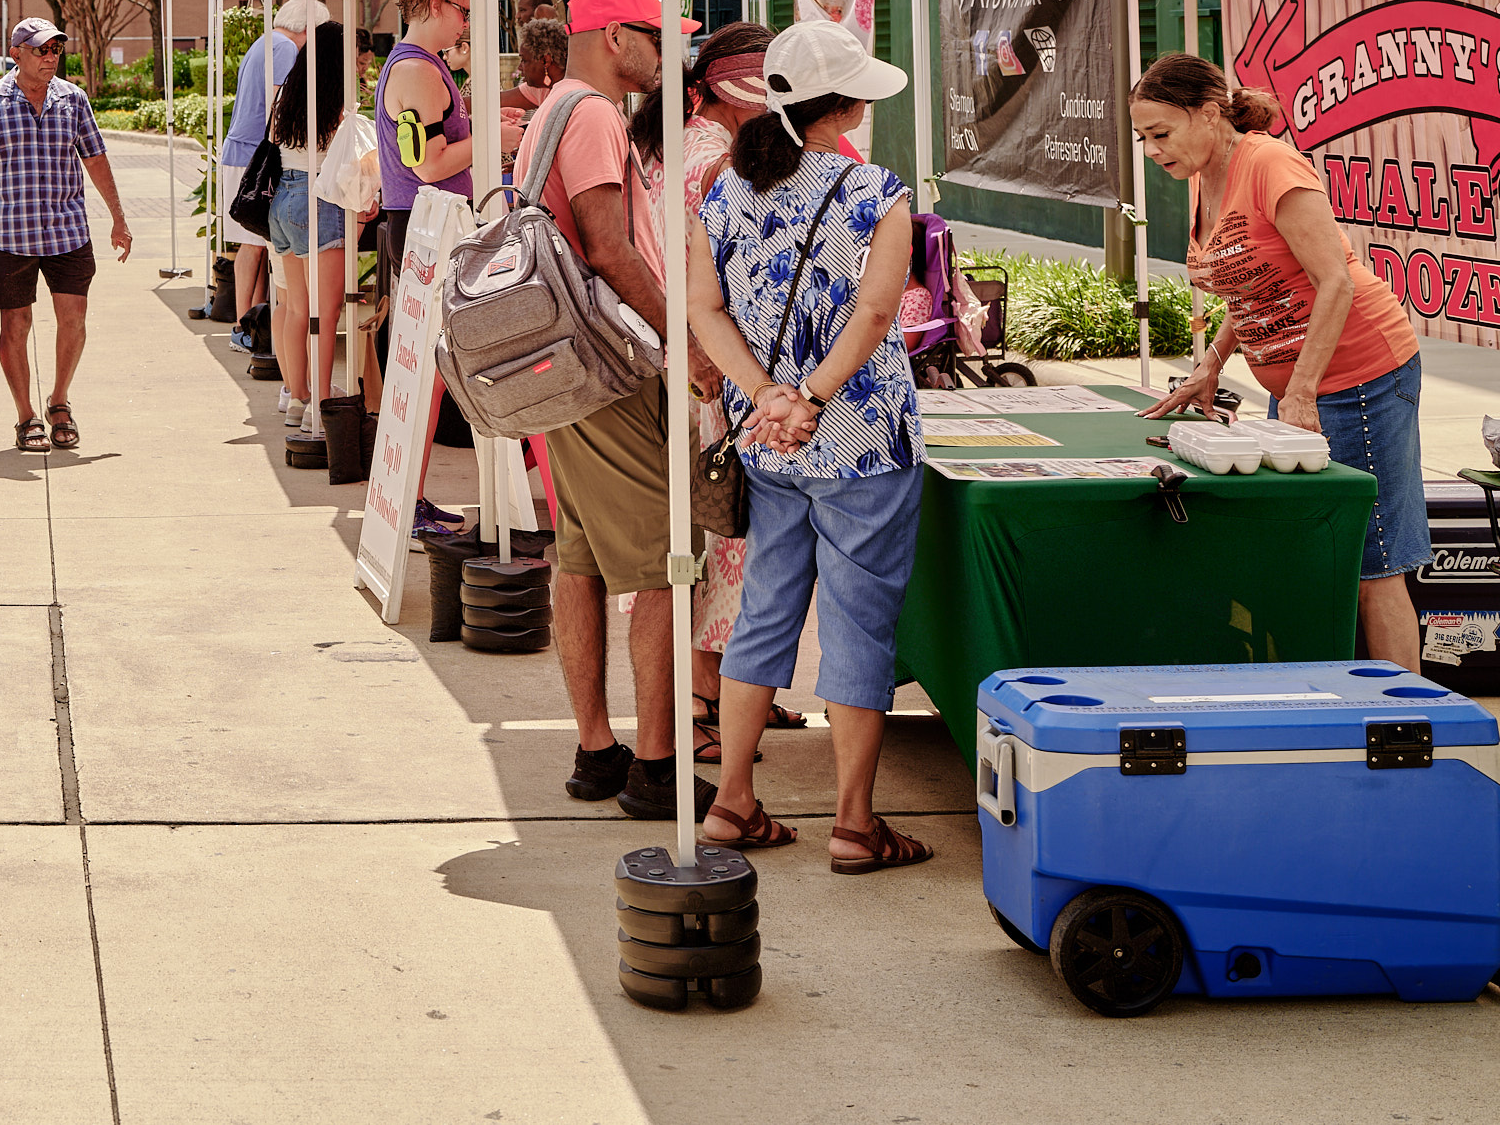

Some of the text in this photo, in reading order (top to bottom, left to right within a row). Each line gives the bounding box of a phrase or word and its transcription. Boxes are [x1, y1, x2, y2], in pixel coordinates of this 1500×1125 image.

[1291, 27, 1500, 132] GRANNY'
[1044, 133, 1108, 172] Refresher Spray
[1301, 152, 1500, 241] MALE
[401, 284, 427, 331] Granny's
[394, 333, 419, 375] Tamales
[390, 383, 410, 424] Voted
[384, 433, 402, 476] Top 10
[368, 476, 376, 508] In
[1428, 616, 1456, 626] Coleman
[1434, 632, 1445, 641] 316
